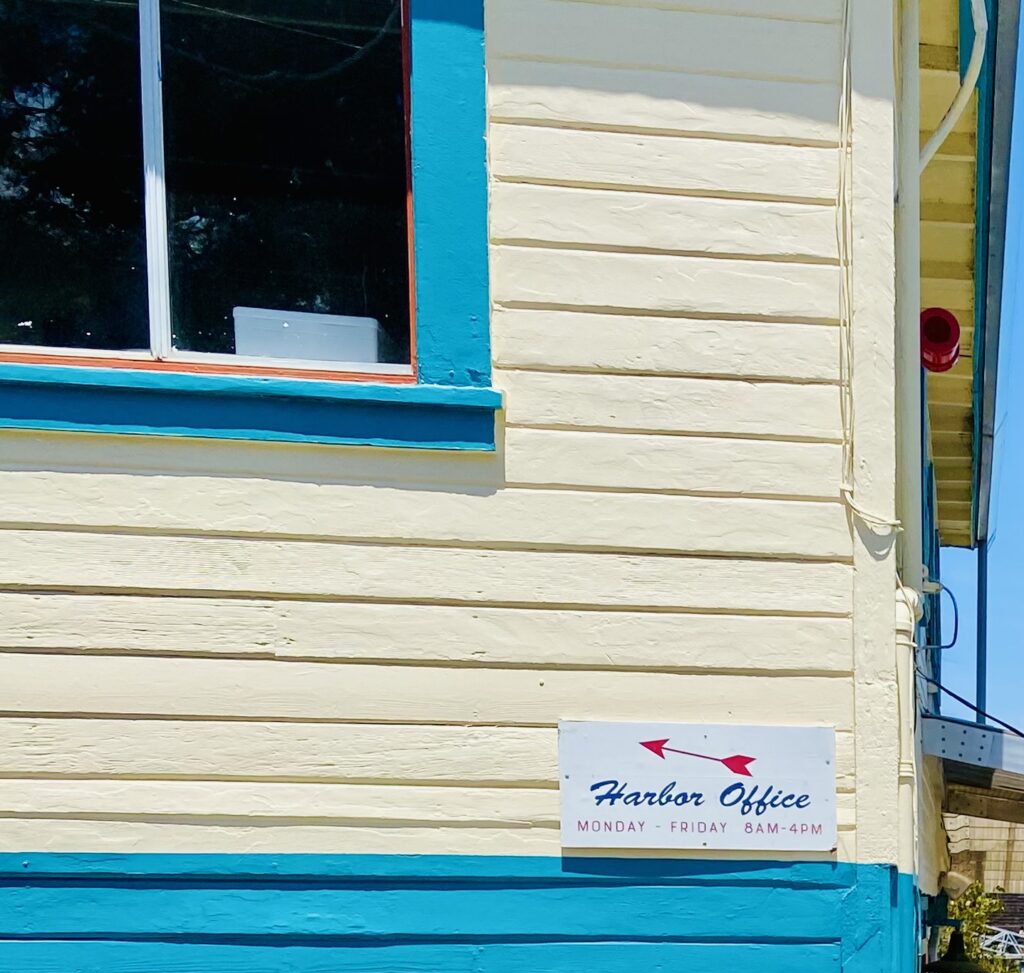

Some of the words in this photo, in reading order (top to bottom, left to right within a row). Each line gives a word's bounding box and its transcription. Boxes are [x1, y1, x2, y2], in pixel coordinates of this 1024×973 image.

[590, 780, 704, 806] Harbor
[720, 782, 811, 816] Office
[577, 820, 646, 833] MONDAY
[670, 821, 727, 833] FRIDAY
[744, 822, 823, 835] 8AM-4PM
